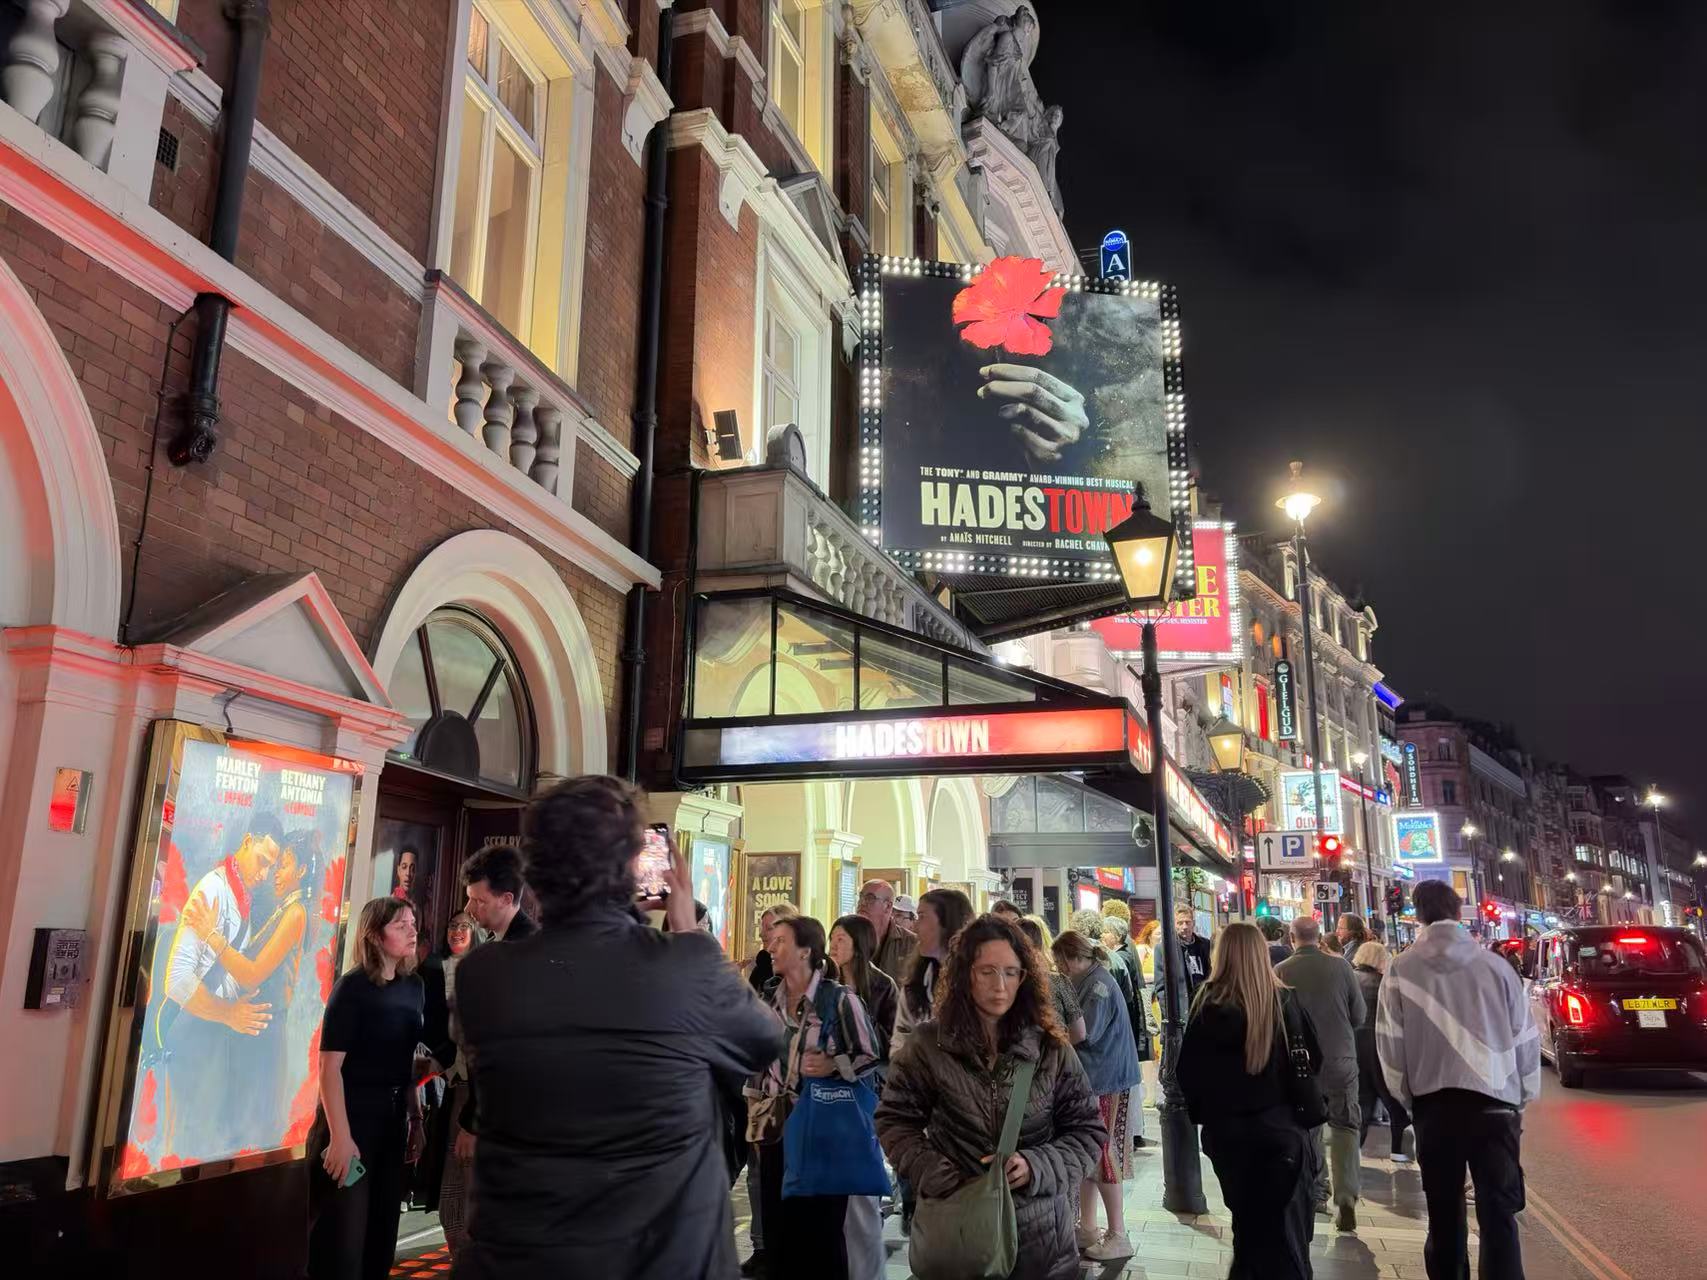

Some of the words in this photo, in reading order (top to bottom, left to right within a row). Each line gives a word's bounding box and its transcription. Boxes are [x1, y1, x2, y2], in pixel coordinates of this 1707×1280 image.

[920, 466, 933, 476] THE
[966, 470, 980, 479] AND
[1030, 475, 1084, 487] AWARD-WINNING
[1086, 477, 1103, 488] BEST
[1105, 478, 1135, 490] MUSICAL
[920, 481, 1134, 535] HADESTOWN
[949, 532, 973, 544] ANAÏS
[975, 534, 1012, 546] MITCHELL
[1022, 540, 1045, 548] DIRECTED
[1055, 539, 1084, 550] RACHEL
[1279, 674, 1293, 735] GIELGUD
[835, 719, 989, 758] HADESTOWN
[216, 755, 262, 778] MARLEY
[215, 772, 259, 794] FENTON
[280, 769, 326, 790] BETHANY
[280, 785, 323, 805] ANTONIA
[1286, 837, 1301, 856] P
[752, 876, 761, 891] A
[763, 875, 793, 891] LOVE
[755, 892, 790, 908] SONG
